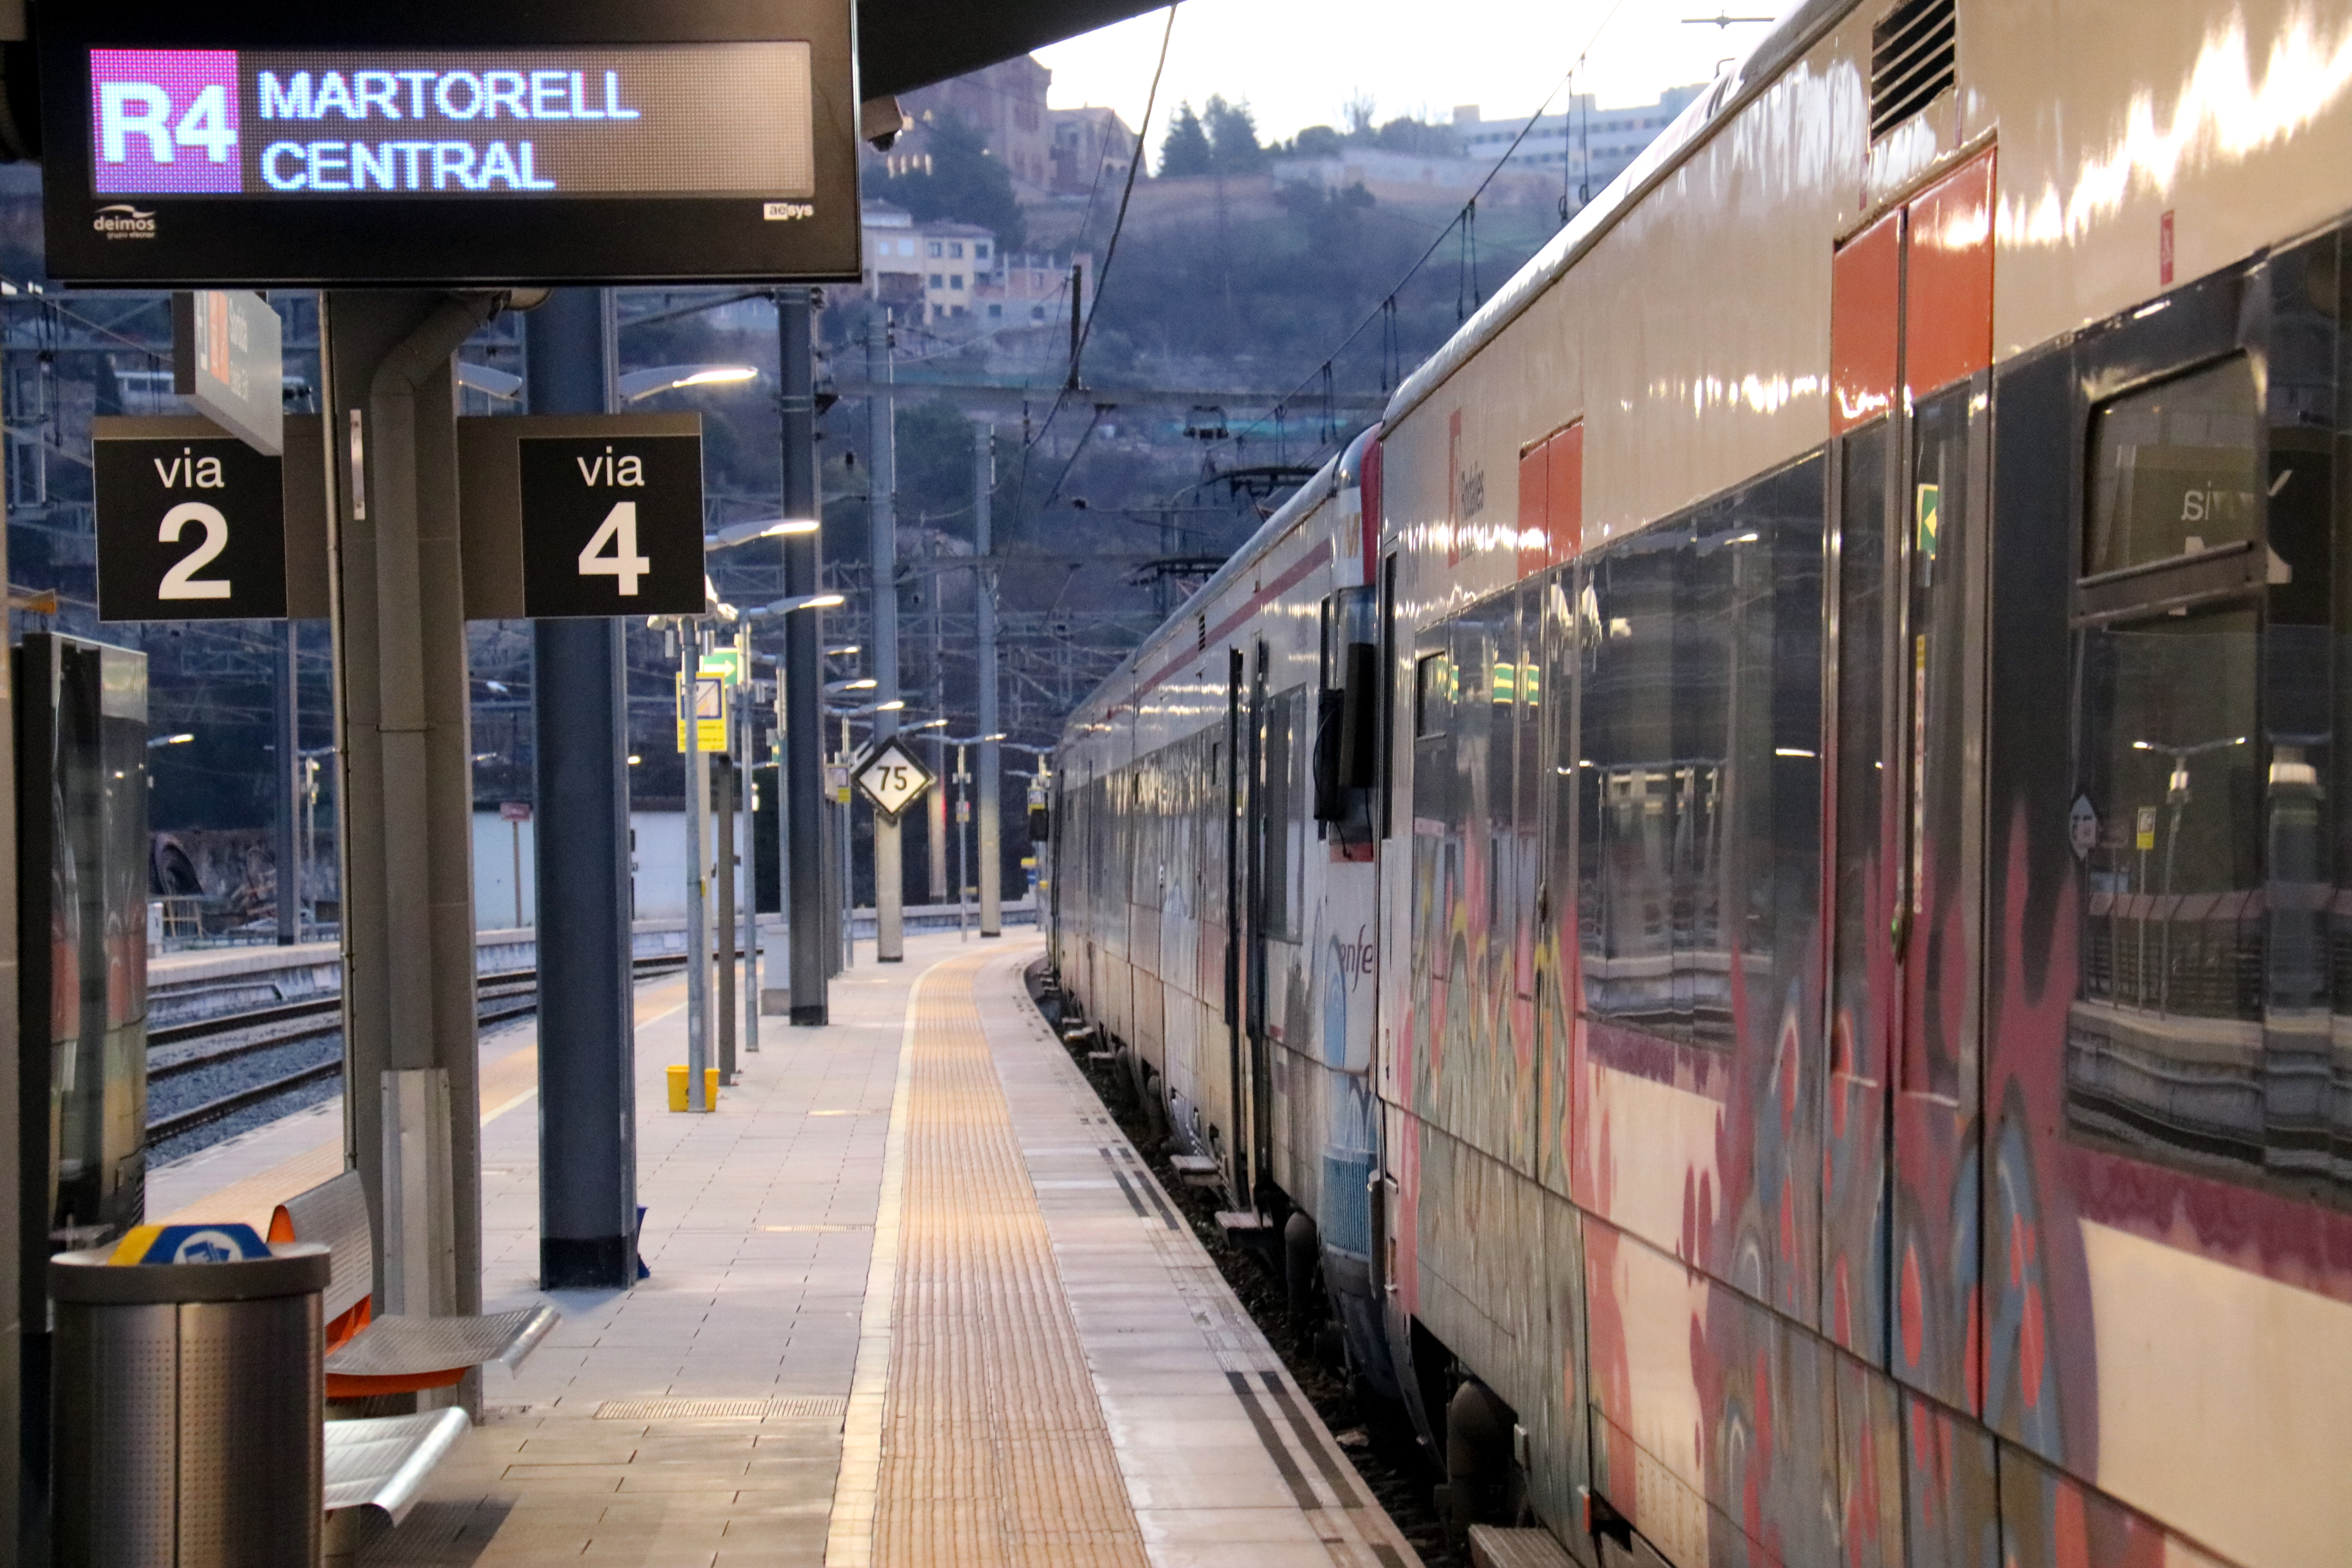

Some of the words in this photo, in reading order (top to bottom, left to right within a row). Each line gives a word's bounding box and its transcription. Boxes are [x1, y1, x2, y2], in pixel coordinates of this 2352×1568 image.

[258, 71, 641, 119] MARTORELL
[101, 82, 237, 163] R4
[262, 142, 556, 190] CENTRAL
[94, 215, 155, 231] deimos
[769, 204, 814, 220] aesys
[155, 448, 225, 488] via
[578, 447, 645, 487] via
[159, 502, 231, 600] 2
[579, 502, 650, 596] 4
[876, 766, 908, 792] 75
[1337, 924, 1373, 994] enfe
